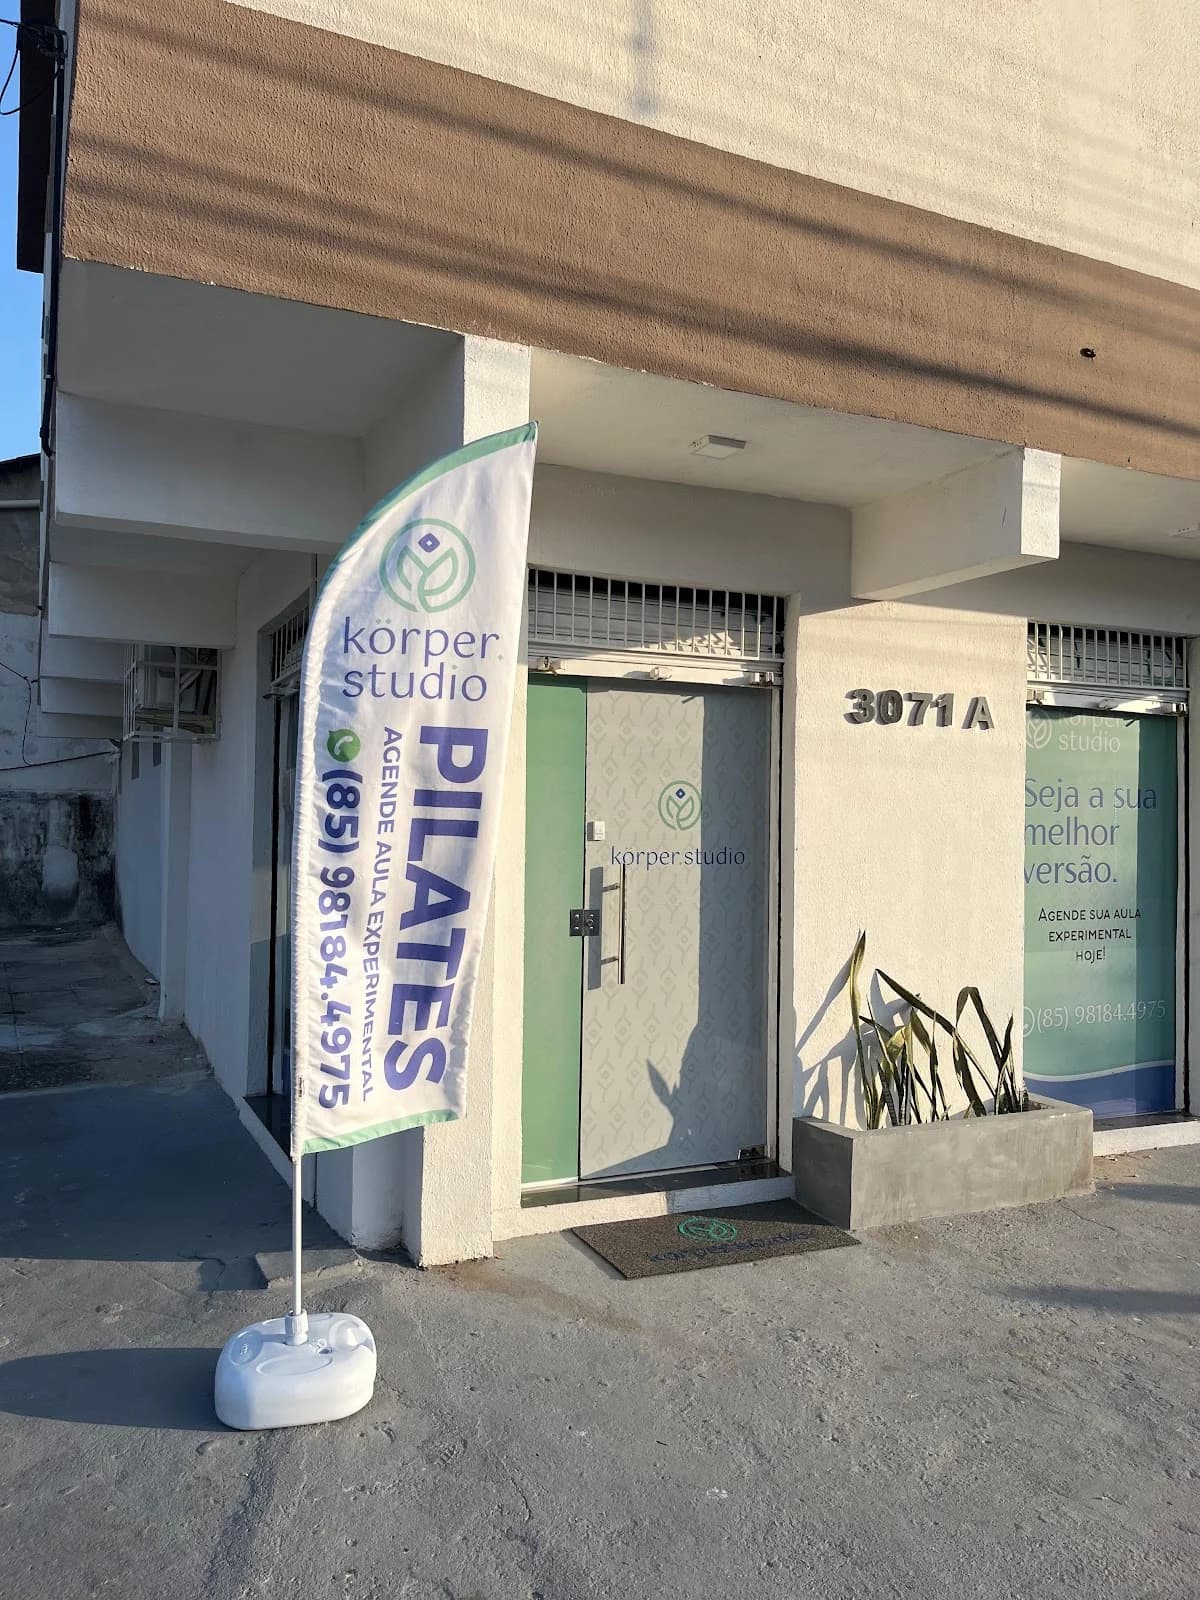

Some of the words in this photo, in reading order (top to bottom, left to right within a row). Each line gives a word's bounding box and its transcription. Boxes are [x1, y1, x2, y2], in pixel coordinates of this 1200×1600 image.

[342, 662, 488, 702] studio
[843, 688, 955, 727] 3071
[961, 696, 995, 730] A
[1058, 730, 1121, 753] studio
[377, 726, 403, 835] AGENDE
[1023, 777, 1079, 813] Seja
[1089, 786, 1104, 808] a
[1114, 786, 1157, 809] sua
[318, 769, 363, 854] (85)
[1023, 816, 1120, 846] melhor
[370, 840, 392, 907] AULA
[1023, 855, 1118, 884] versão.
[384, 726, 489, 1091] PILATES
[1089, 909, 1111, 920] SUA
[1113, 908, 1142, 919] AULA
[1048, 928, 1132, 942] EXPERIMENTAL
[318, 866, 356, 1109] 98184.4975
[361, 910, 385, 1102] EXPERIMENTAL
[1036, 1006, 1069, 1033] (85)
[1074, 1000, 1166, 1025] 98184.4975
